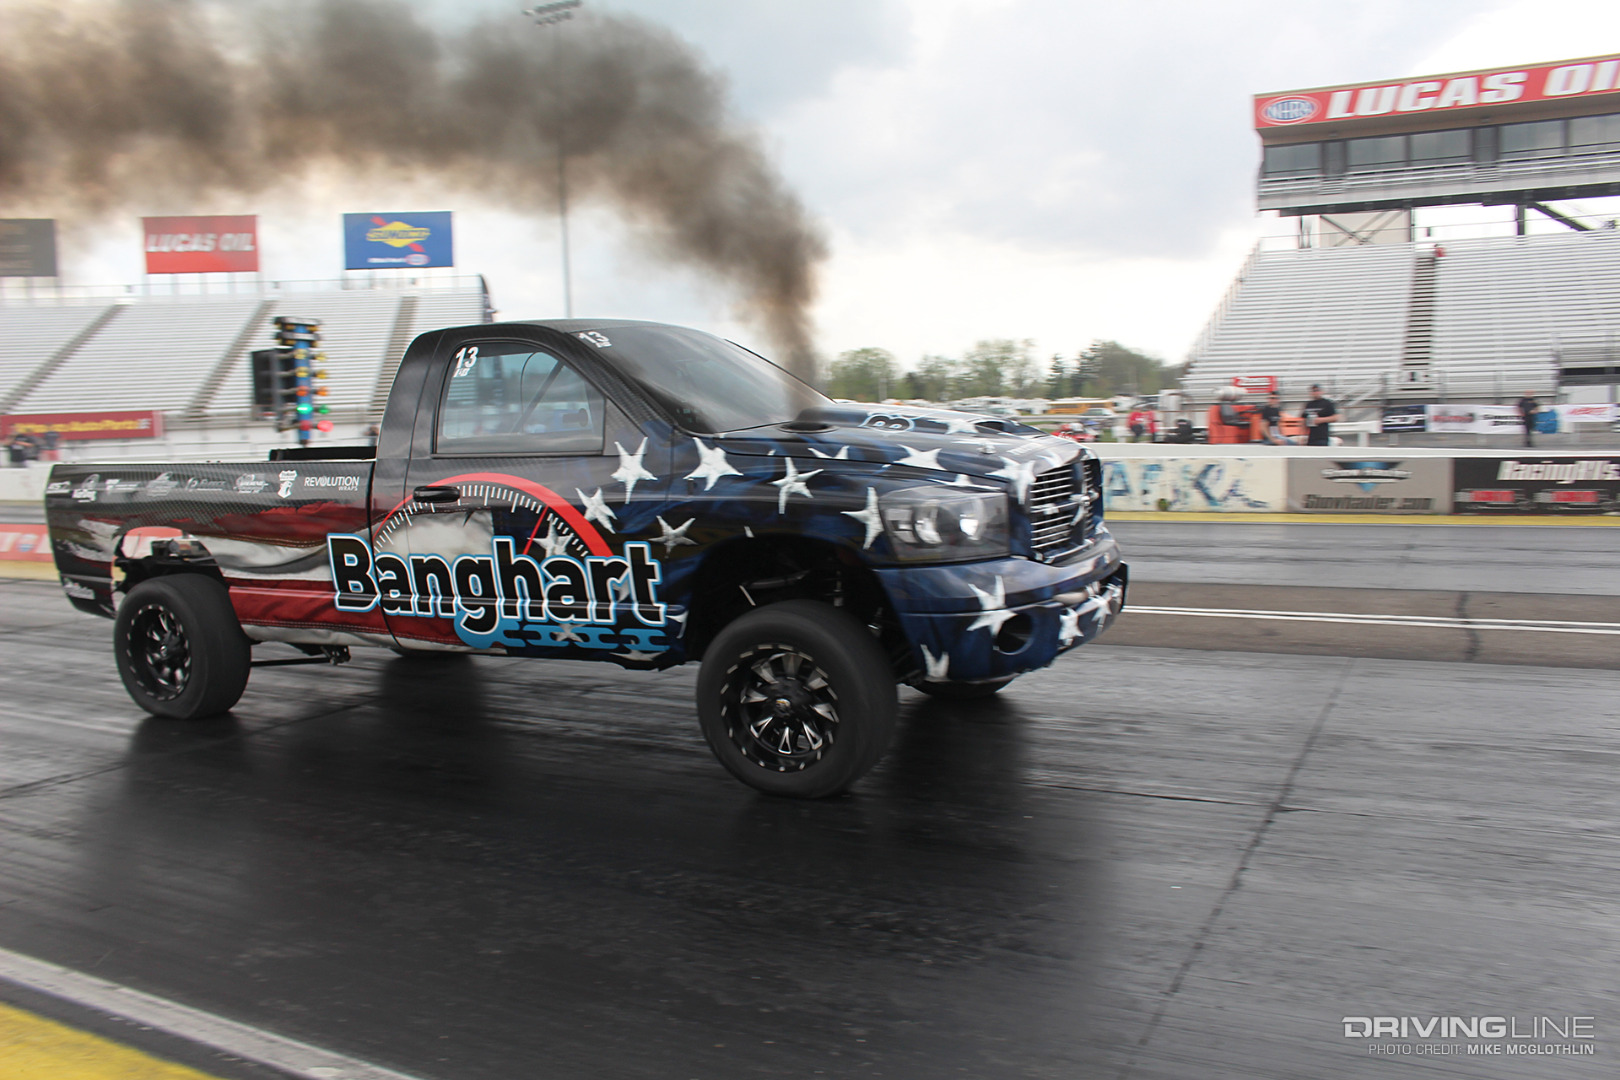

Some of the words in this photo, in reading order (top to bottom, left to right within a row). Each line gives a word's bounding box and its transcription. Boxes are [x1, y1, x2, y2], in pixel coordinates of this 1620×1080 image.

[1325, 71, 1529, 120] LUCAS
[1542, 60, 1620, 97] OI
[147, 233, 218, 252] LUCAS
[219, 233, 255, 251] OIL
[577, 331, 609, 344] 13
[455, 346, 480, 369] 13
[303, 475, 361, 488] REVOLUTION
[327, 533, 667, 635] Banghart
